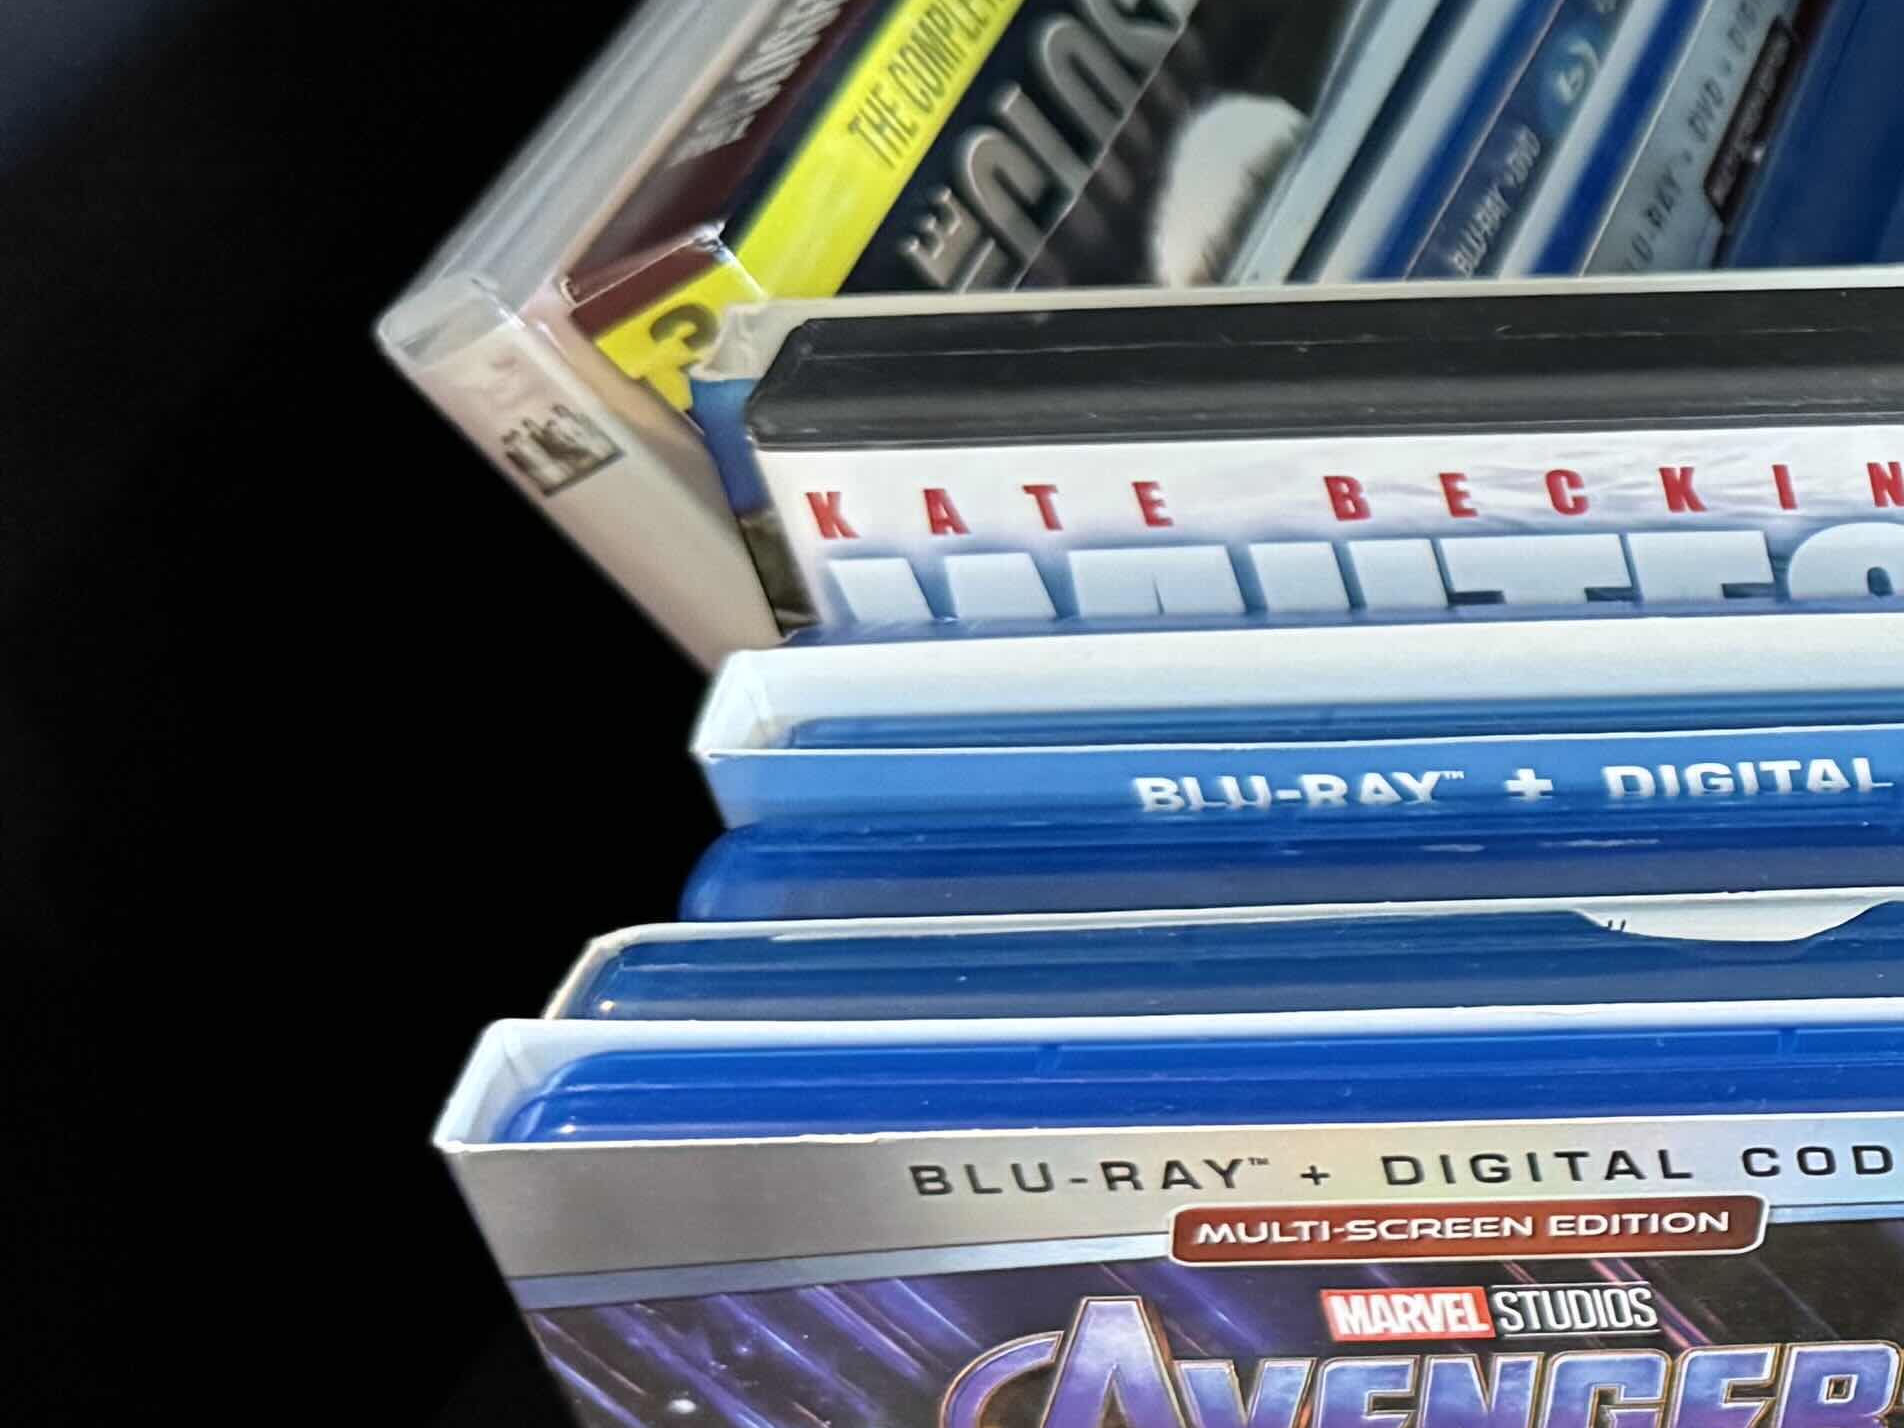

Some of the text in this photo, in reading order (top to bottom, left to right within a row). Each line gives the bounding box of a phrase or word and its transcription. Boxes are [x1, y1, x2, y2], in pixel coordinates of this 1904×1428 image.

[846, 80, 918, 172] THE
[804, 479, 1175, 541] KATE
[1602, 756, 1895, 801] DIGITAL
[1381, 1148, 1696, 1189] DIGITAL
[1195, 1207, 1732, 1246] MULTI-SCREEN EDITION
[1328, 1285, 1659, 1338] MARVEL STUDIOS
